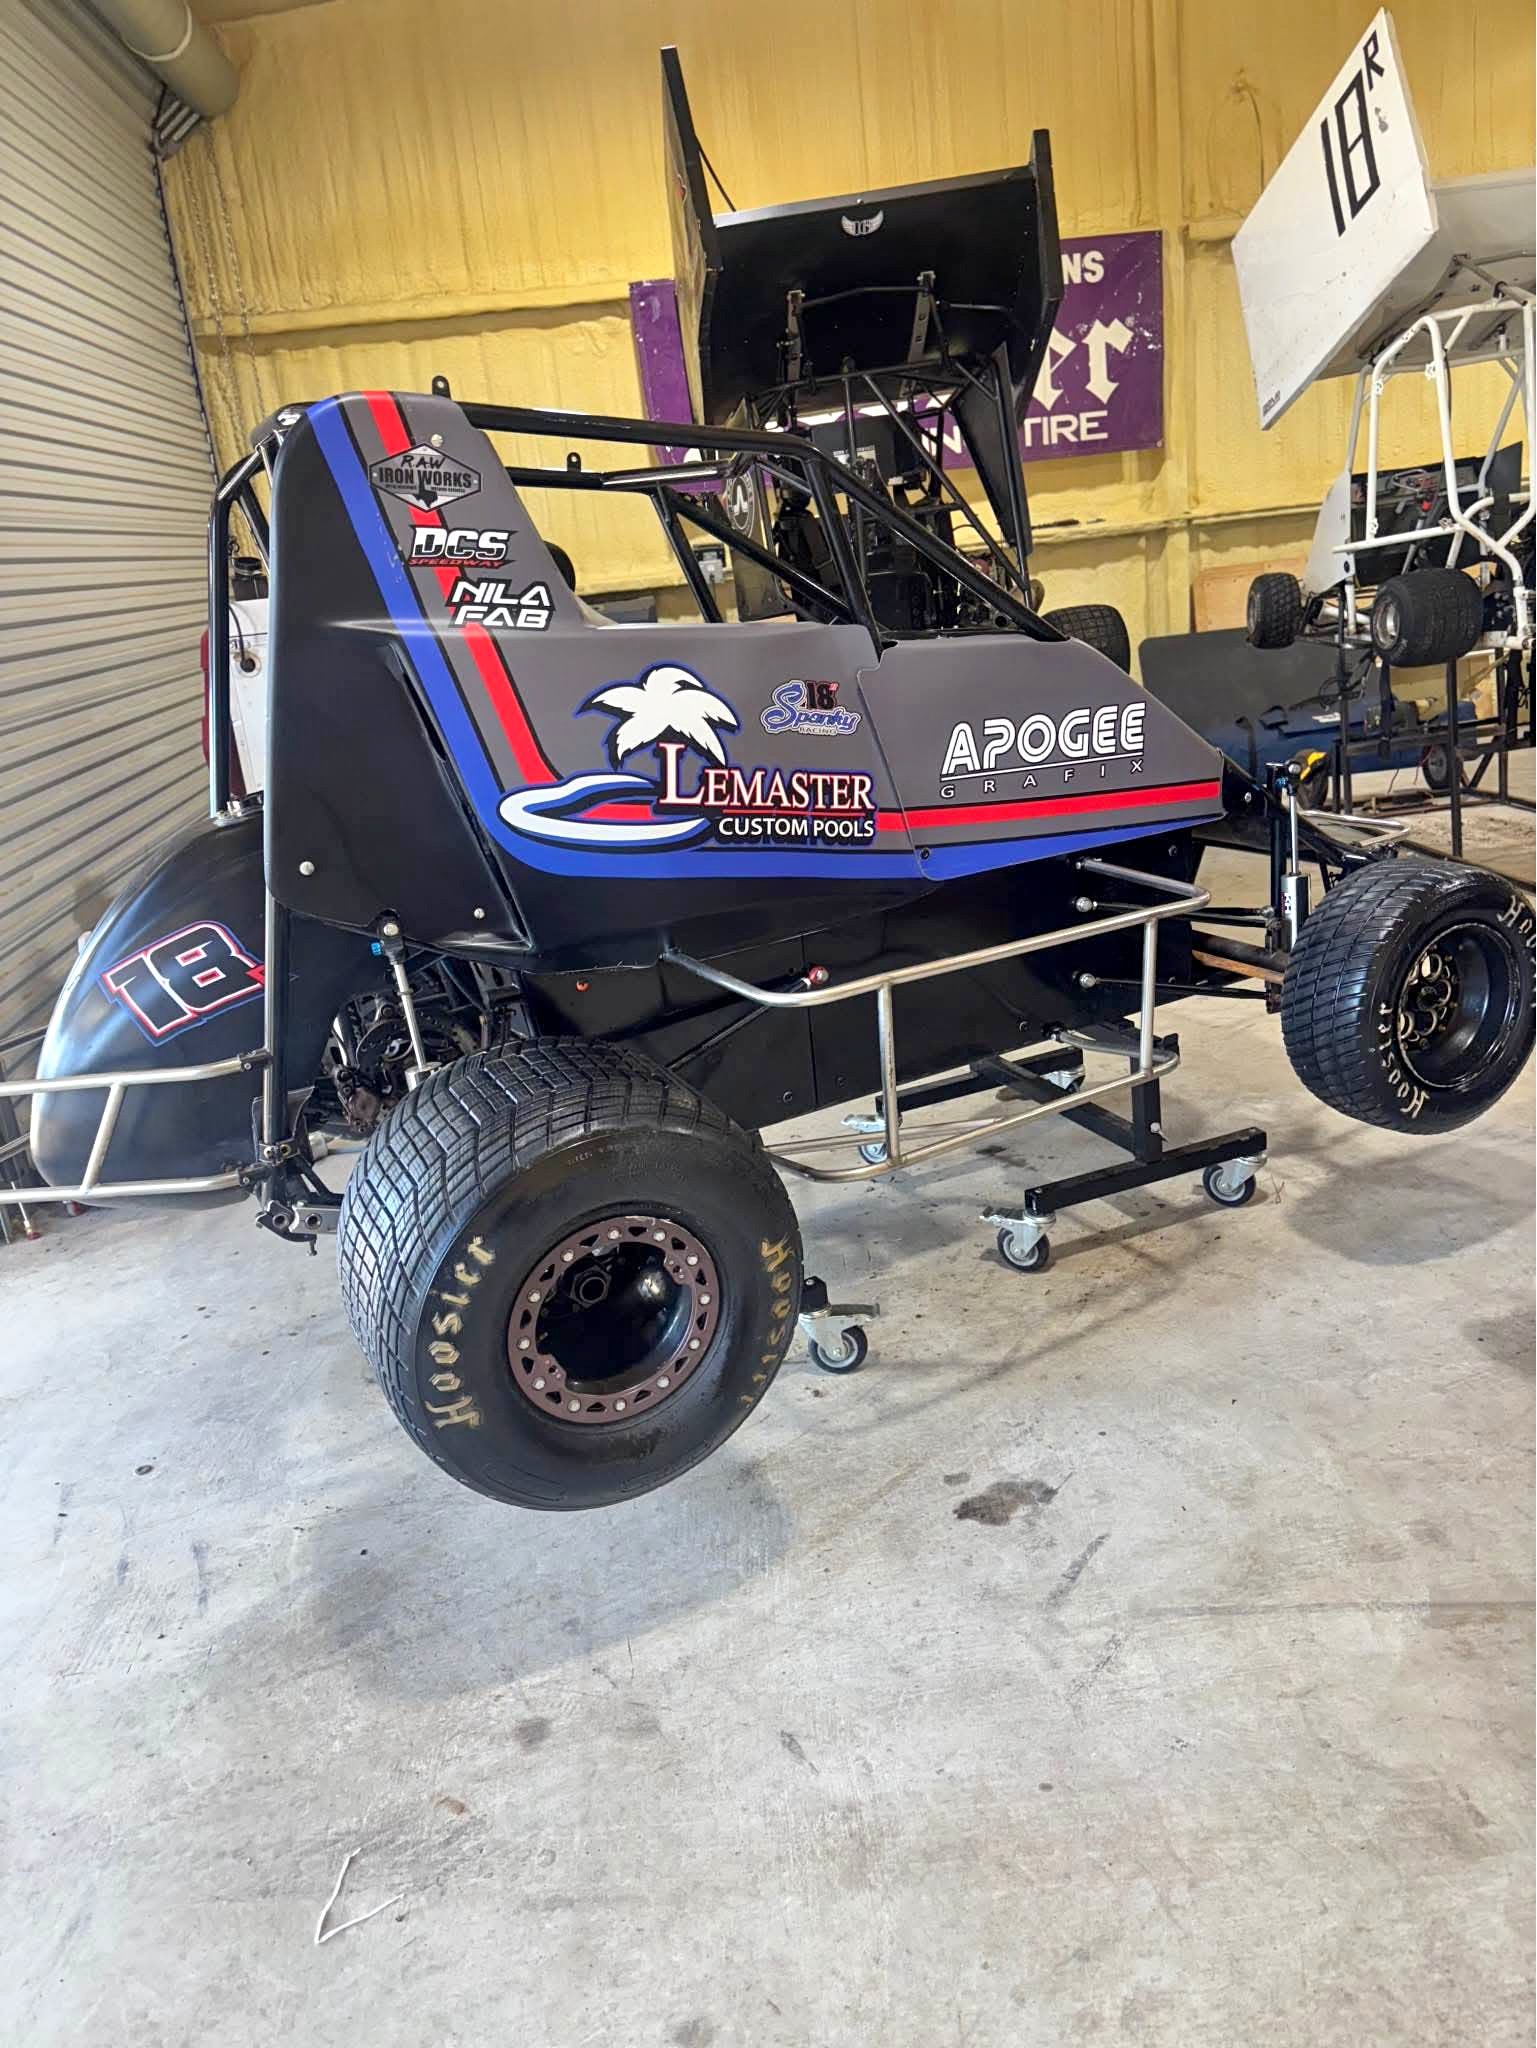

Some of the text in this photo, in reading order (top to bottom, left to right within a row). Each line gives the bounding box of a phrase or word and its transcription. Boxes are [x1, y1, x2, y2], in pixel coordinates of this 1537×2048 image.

[1023, 410, 1109, 448] TIRE
[378, 467, 472, 488] IRON WORKS
[411, 527, 510, 561] DCS
[408, 558, 504, 570] SPEEDWAY
[452, 581, 551, 607] NILA
[454, 605, 550, 628] FAB
[762, 680, 861, 733] Spanky
[799, 725, 838, 735] RACING
[941, 702, 1146, 775] APOGEE
[940, 758, 1143, 798] GRAFIX
[718, 817, 874, 838] CUSTOM POOLS
[425, 1234, 497, 1429] Hoosier
